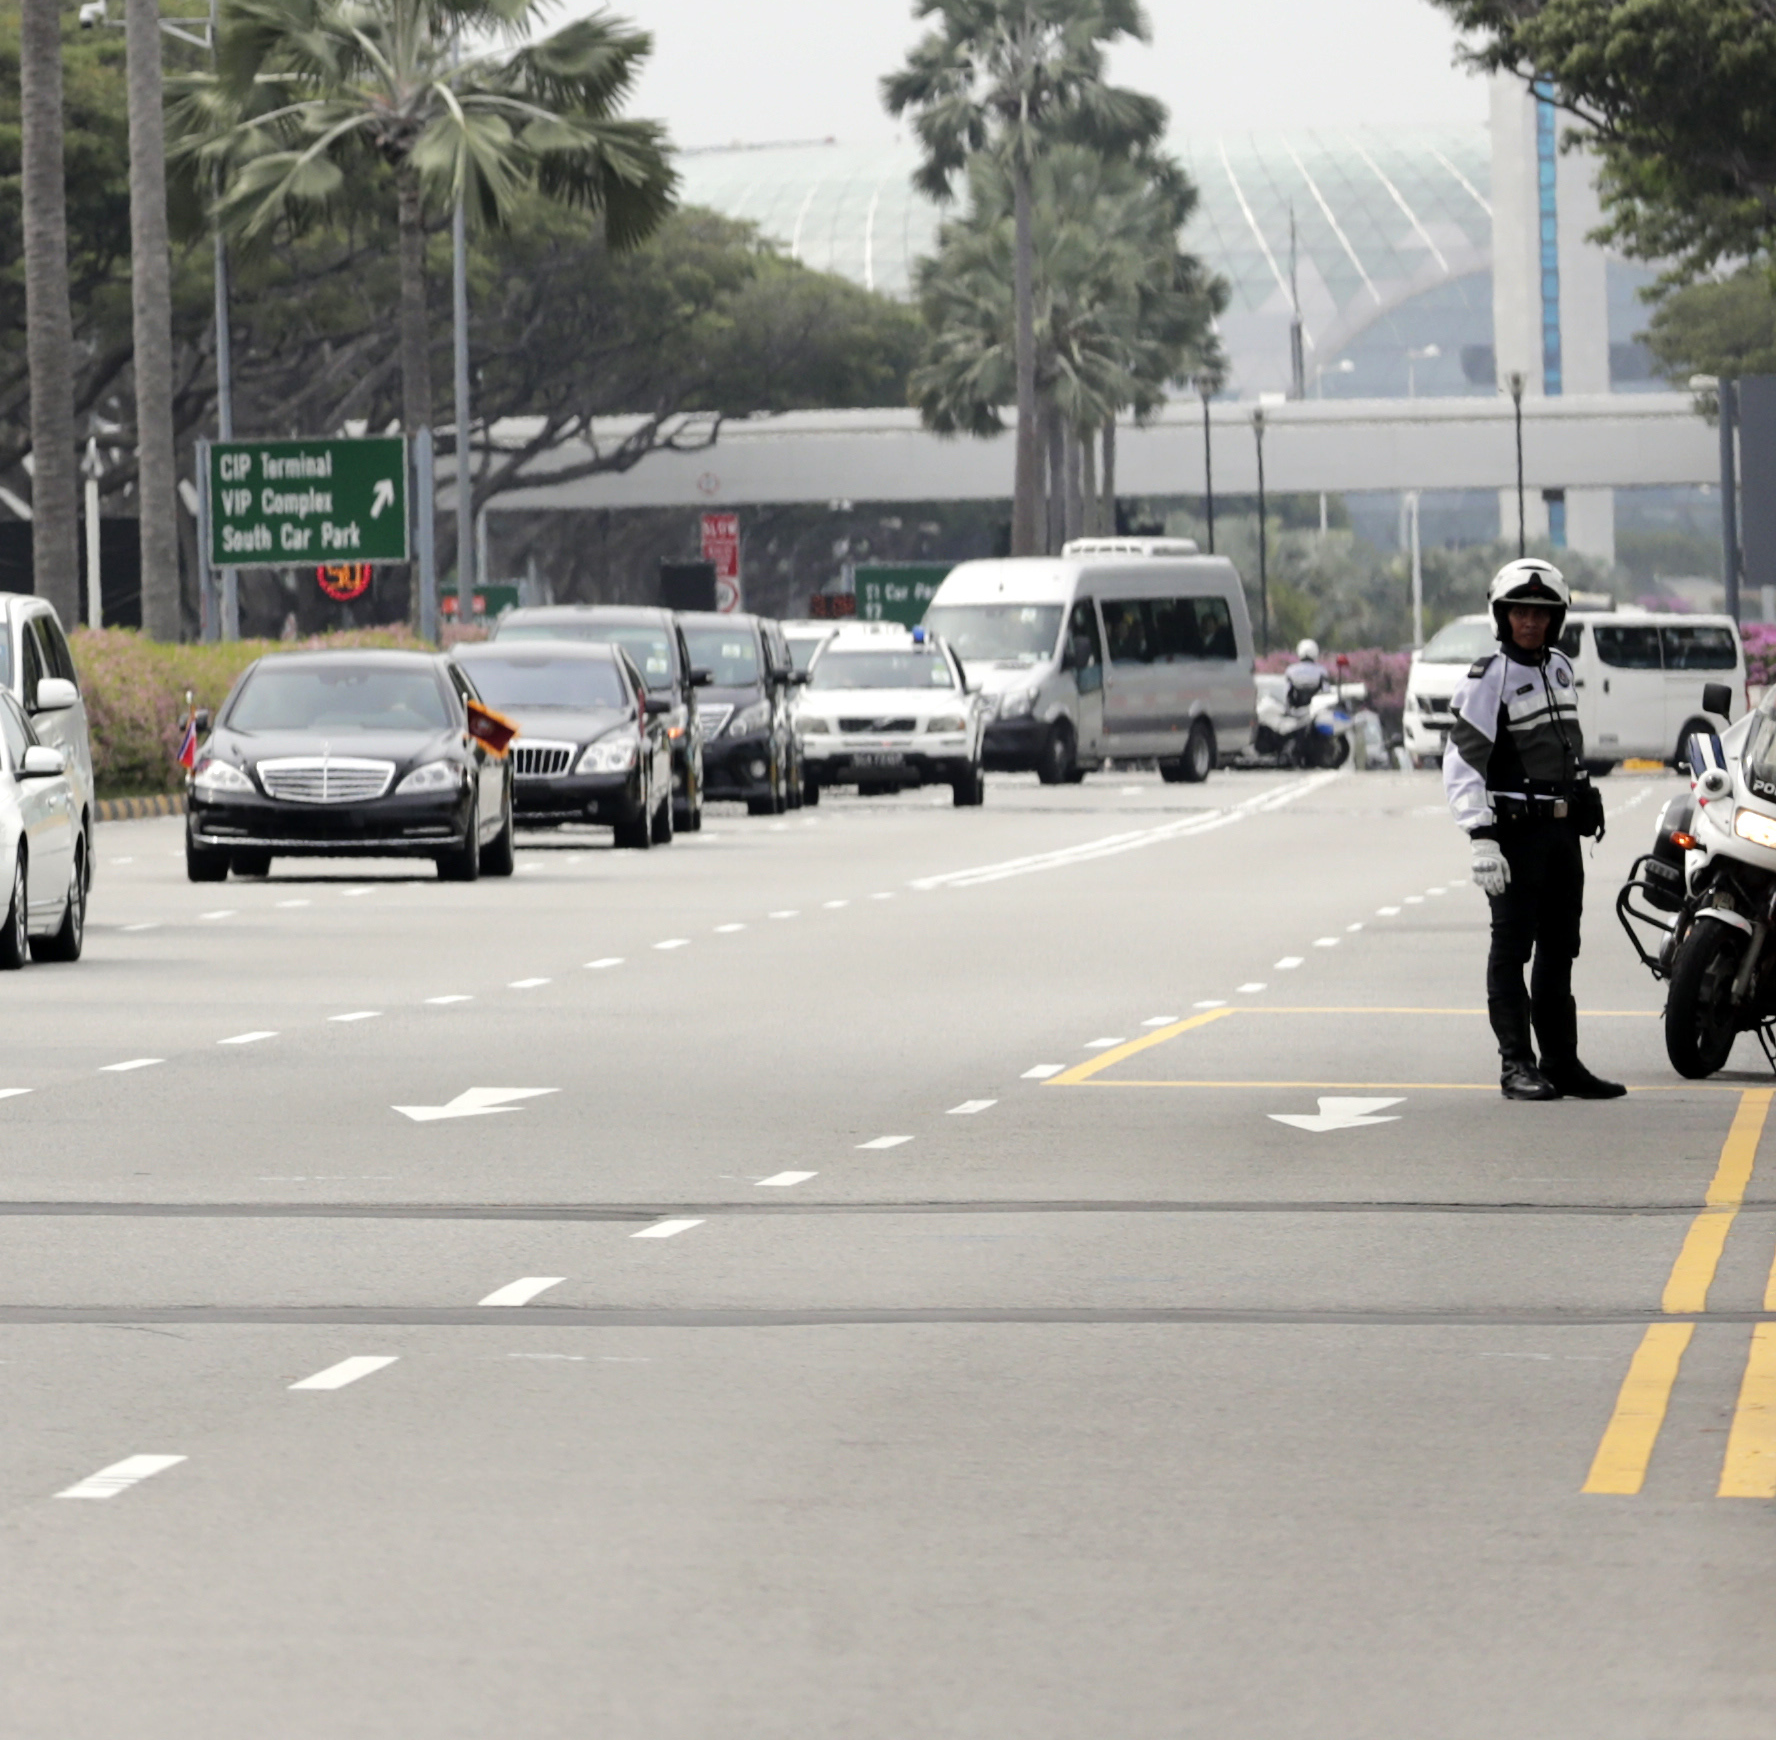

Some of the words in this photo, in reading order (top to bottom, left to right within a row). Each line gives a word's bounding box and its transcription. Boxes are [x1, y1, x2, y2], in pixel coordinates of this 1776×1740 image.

[220, 452, 252, 482] CIP
[260, 449, 333, 480] Terminal
[221, 488, 253, 517] VIP
[261, 486, 334, 520] Complex
[222, 523, 273, 553] South
[280, 522, 312, 550] Car
[321, 520, 361, 549] Park
